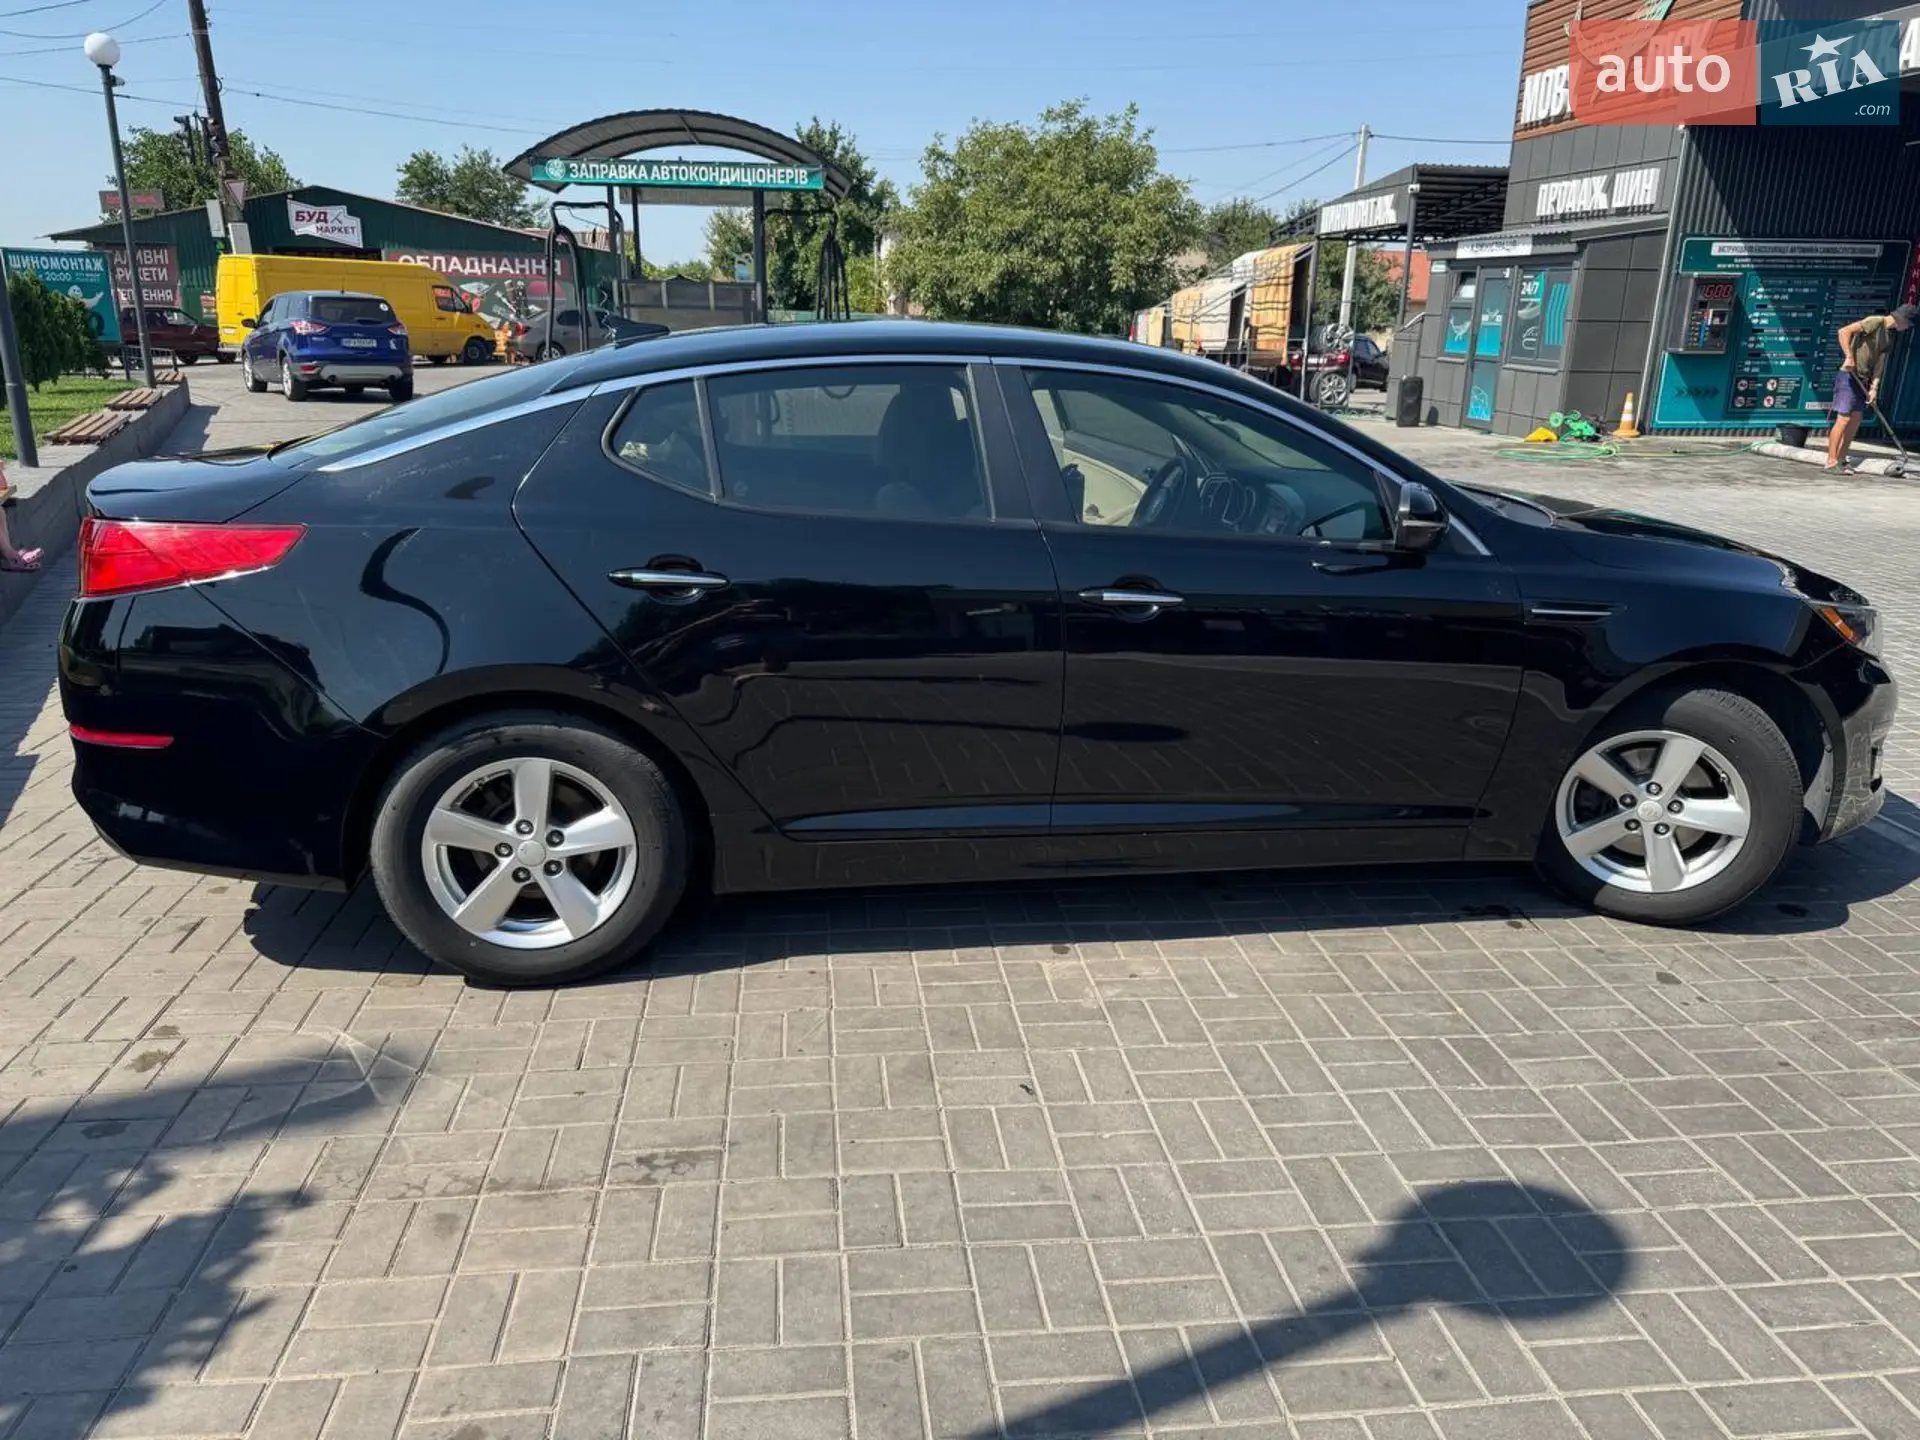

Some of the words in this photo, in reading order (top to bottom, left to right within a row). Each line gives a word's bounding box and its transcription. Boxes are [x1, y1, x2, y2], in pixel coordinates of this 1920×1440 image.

[569, 162, 649, 181] ЗАПРАВКА
[651, 165, 808, 185] АВТОКОНДИЦІОНЕРІВ
[1536, 174, 1608, 217] ПРОДАЖ
[1612, 168, 1661, 208] ШИН
[295, 210, 328, 224] БУД
[316, 225, 356, 235] МАРКЕТ
[8, 254, 104, 271] ШИНОМОНТАЖ
[46, 271, 72, 281] 20:00
[1521, 281, 1540, 295] 24/7
